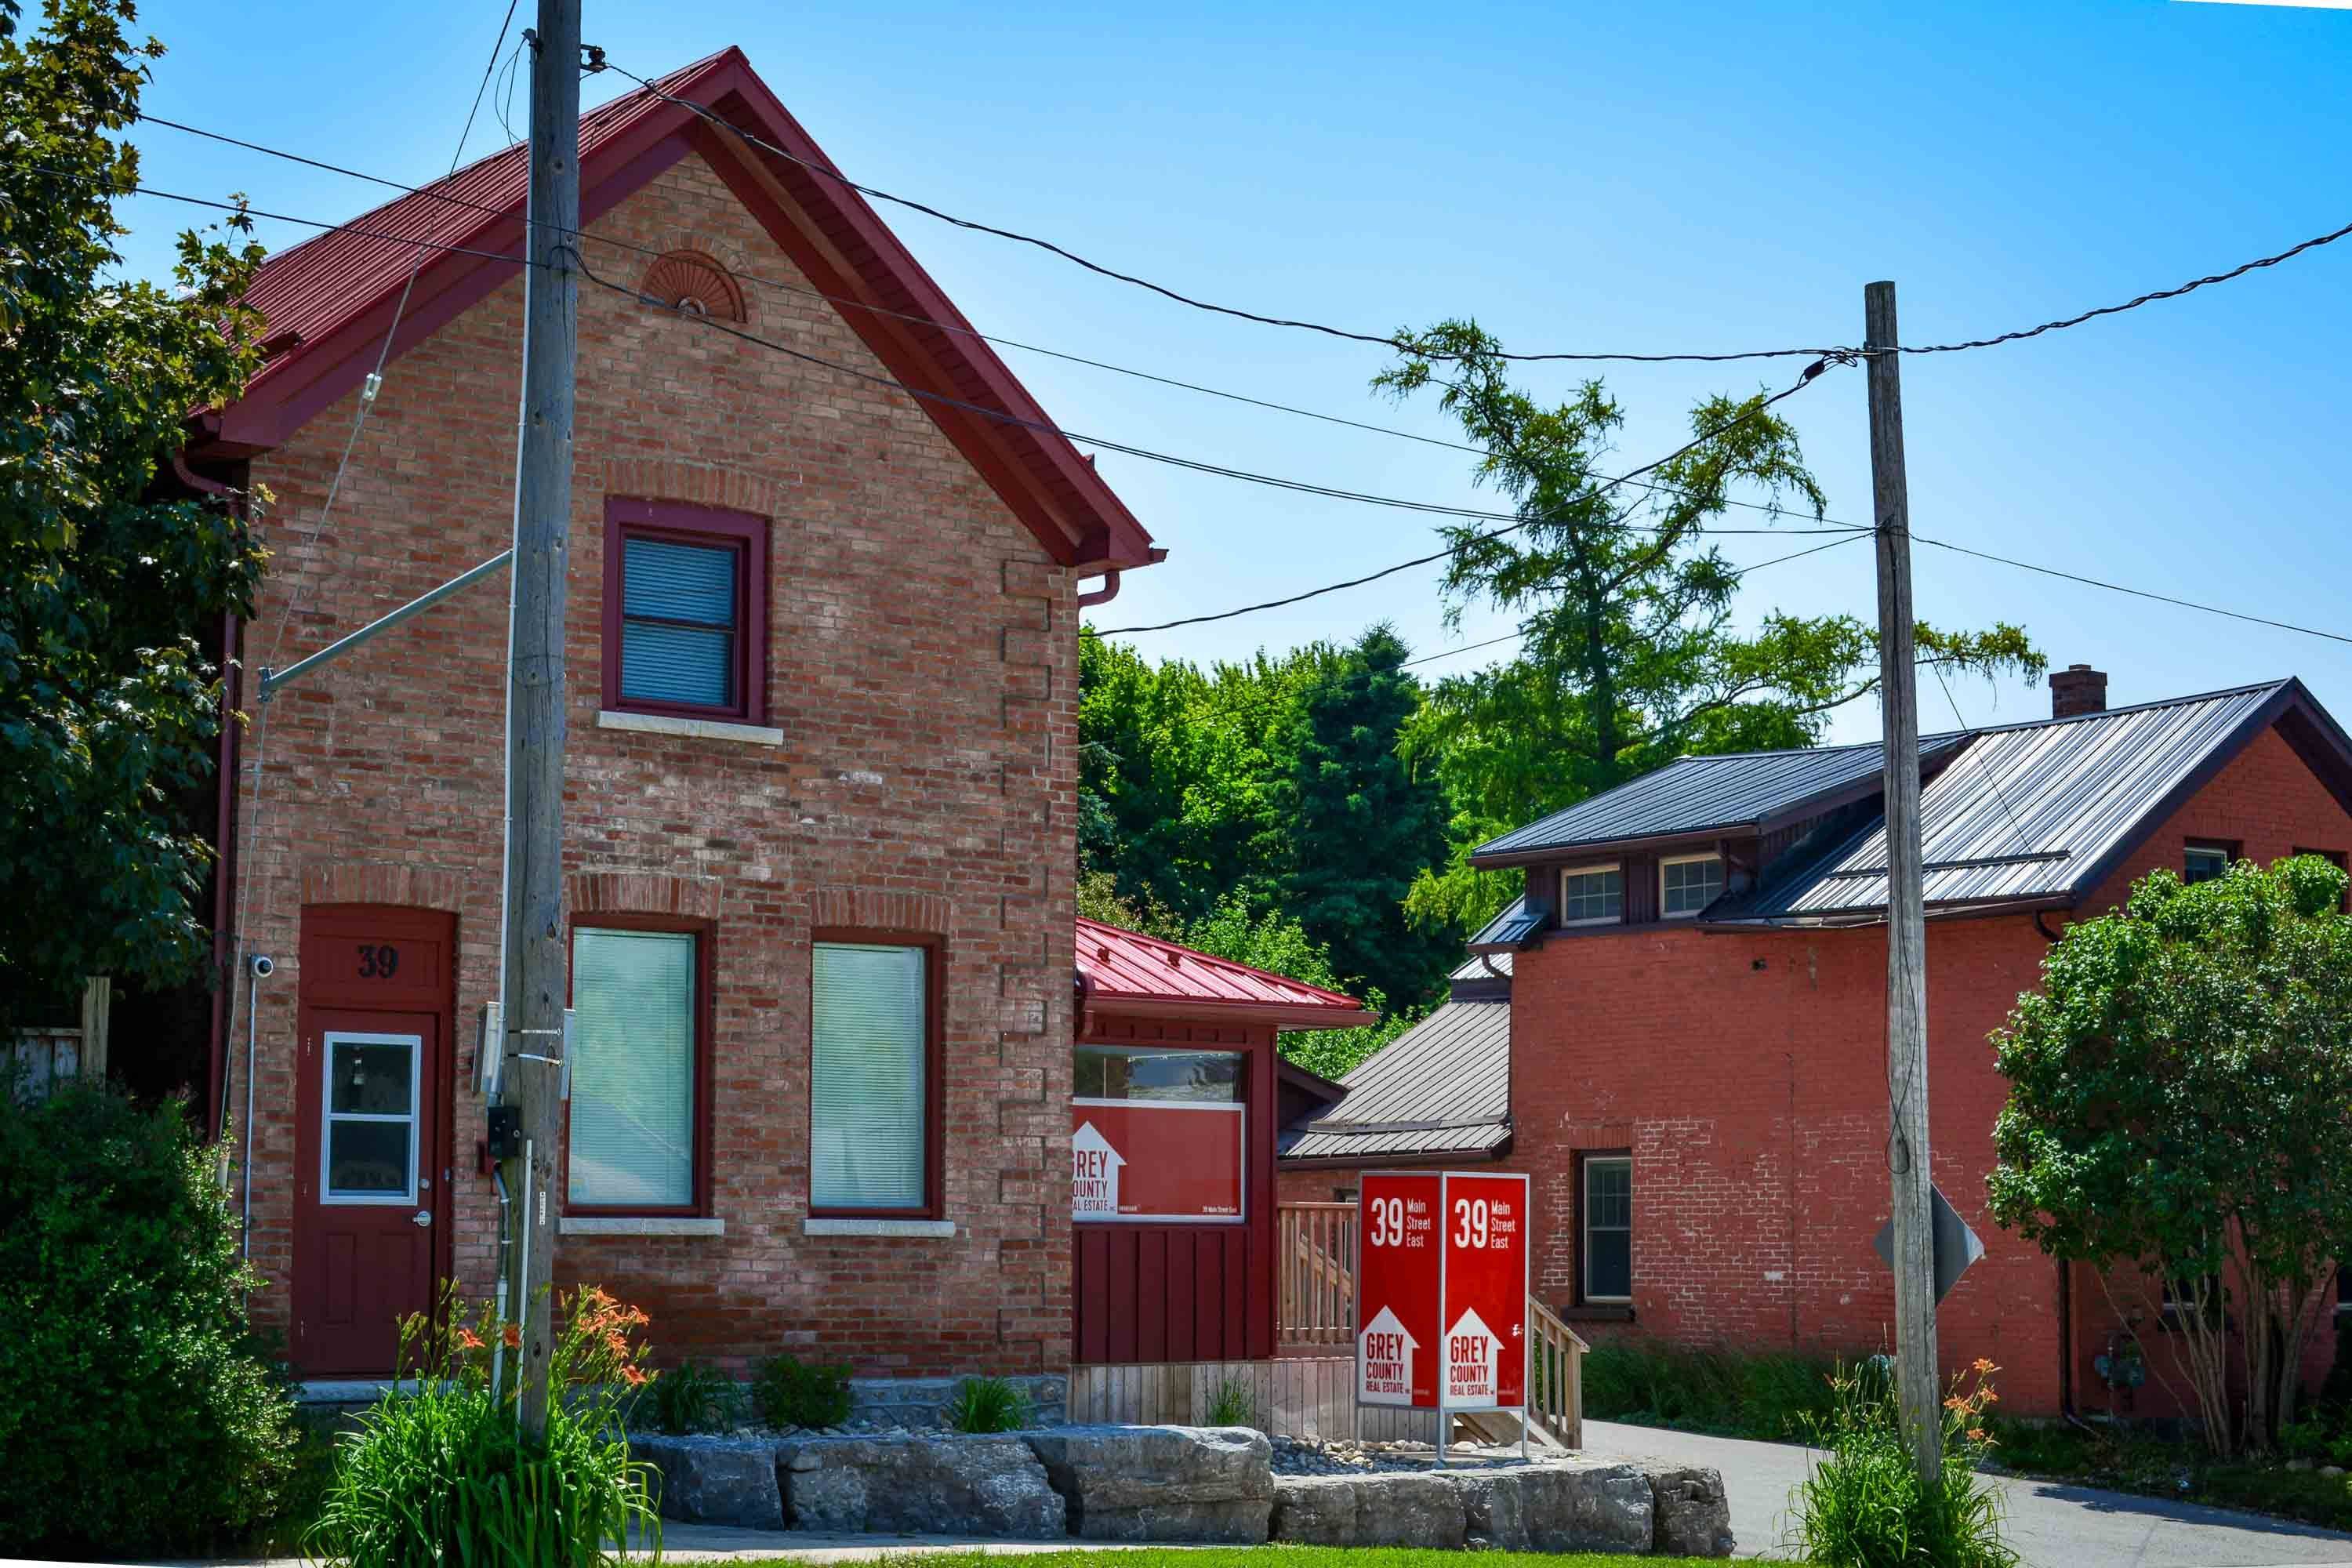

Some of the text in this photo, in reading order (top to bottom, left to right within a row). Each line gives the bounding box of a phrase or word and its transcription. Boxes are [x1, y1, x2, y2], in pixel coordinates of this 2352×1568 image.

[357, 946, 398, 978] 39
[1073, 1150, 1107, 1178] REY
[1073, 1180, 1107, 1198] OUNTY
[1073, 1200, 1081, 1210] AL
[1084, 1200, 1108, 1210] ESTATE
[1406, 1198, 1425, 1213] Main
[1491, 1200, 1510, 1215] Main
[1371, 1198, 1403, 1247] 39
[1406, 1216, 1431, 1230] Street
[1454, 1199, 1487, 1248] 39
[1491, 1218, 1515, 1232] Street
[1406, 1232, 1424, 1247] East
[1491, 1234, 1508, 1248] East
[1367, 1332, 1403, 1360] GREY
[1450, 1336, 1488, 1363] GREY
[1367, 1362, 1403, 1380] COUNTY
[1450, 1365, 1488, 1382] COUNTY
[1367, 1381, 1381, 1392] REAL
[1382, 1382, 1403, 1394] ESTATE
[1450, 1385, 1465, 1396] REAL
[1467, 1385, 1489, 1396] ESTATE
